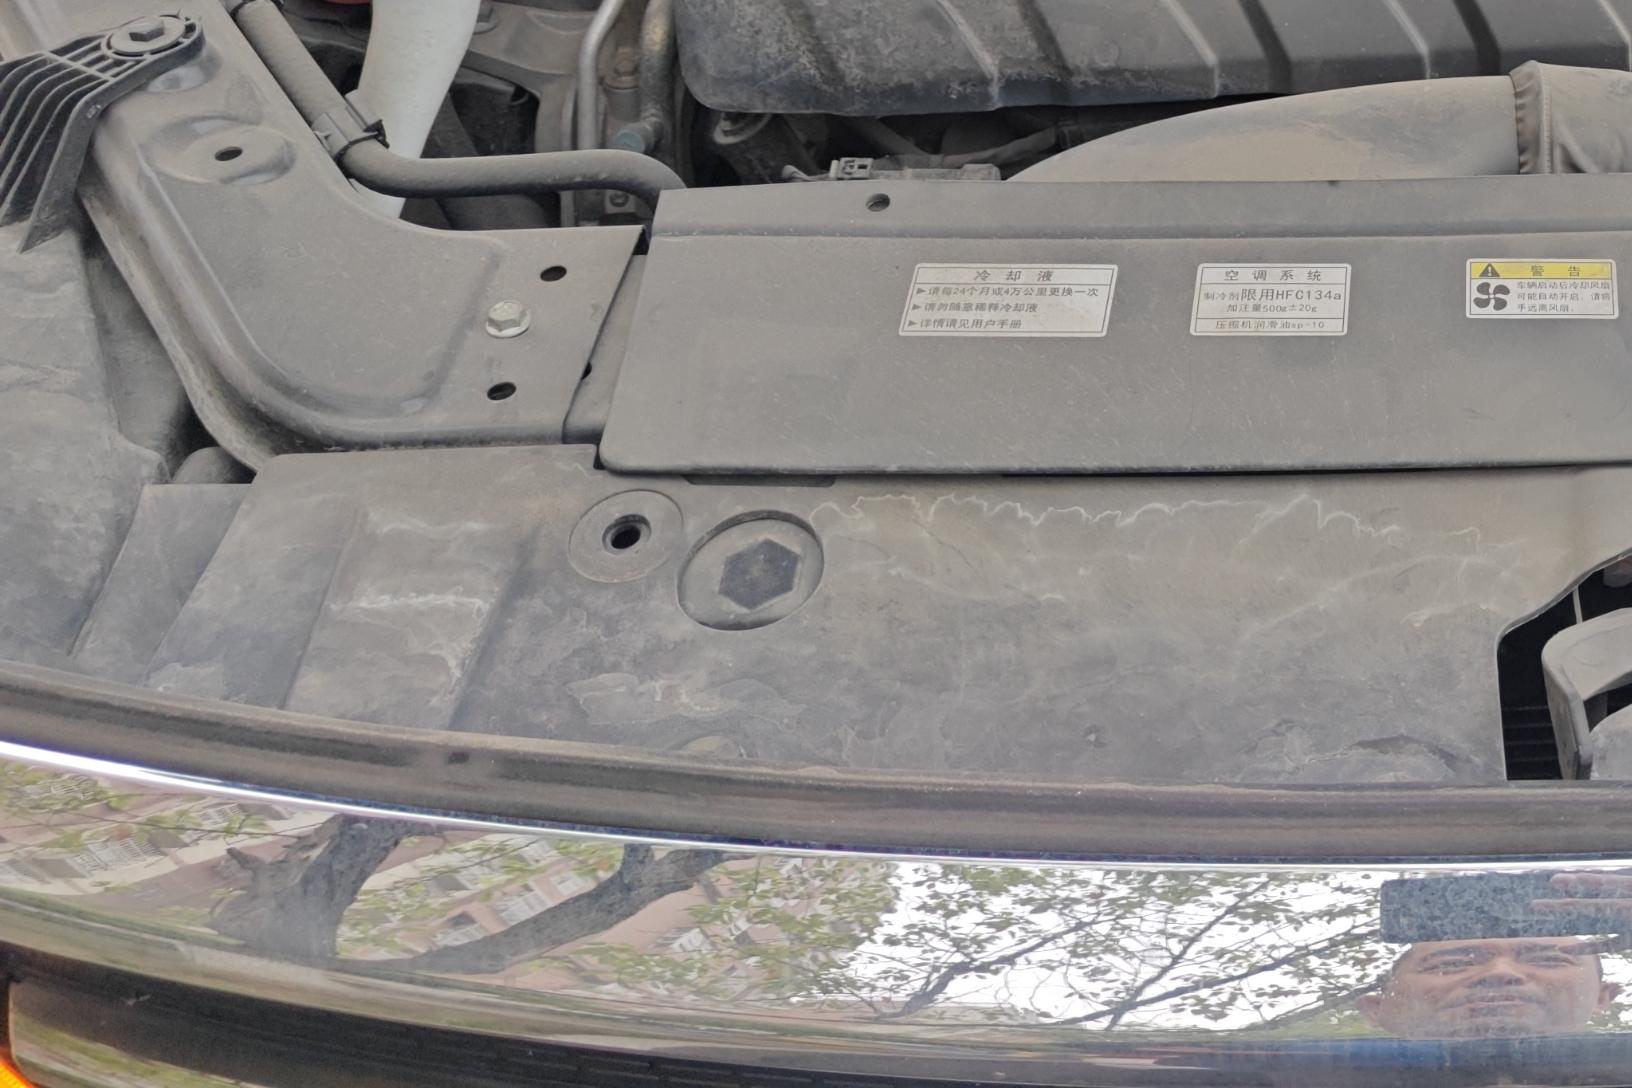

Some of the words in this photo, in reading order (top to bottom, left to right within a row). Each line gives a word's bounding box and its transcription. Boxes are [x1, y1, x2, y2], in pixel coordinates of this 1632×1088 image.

[973, 269, 1054, 282] 冷却液
[1223, 269, 1322, 282] 空调系统
[1530, 265, 1581, 277] 警告
[919, 318, 1023, 329] 详情请见用户手册
